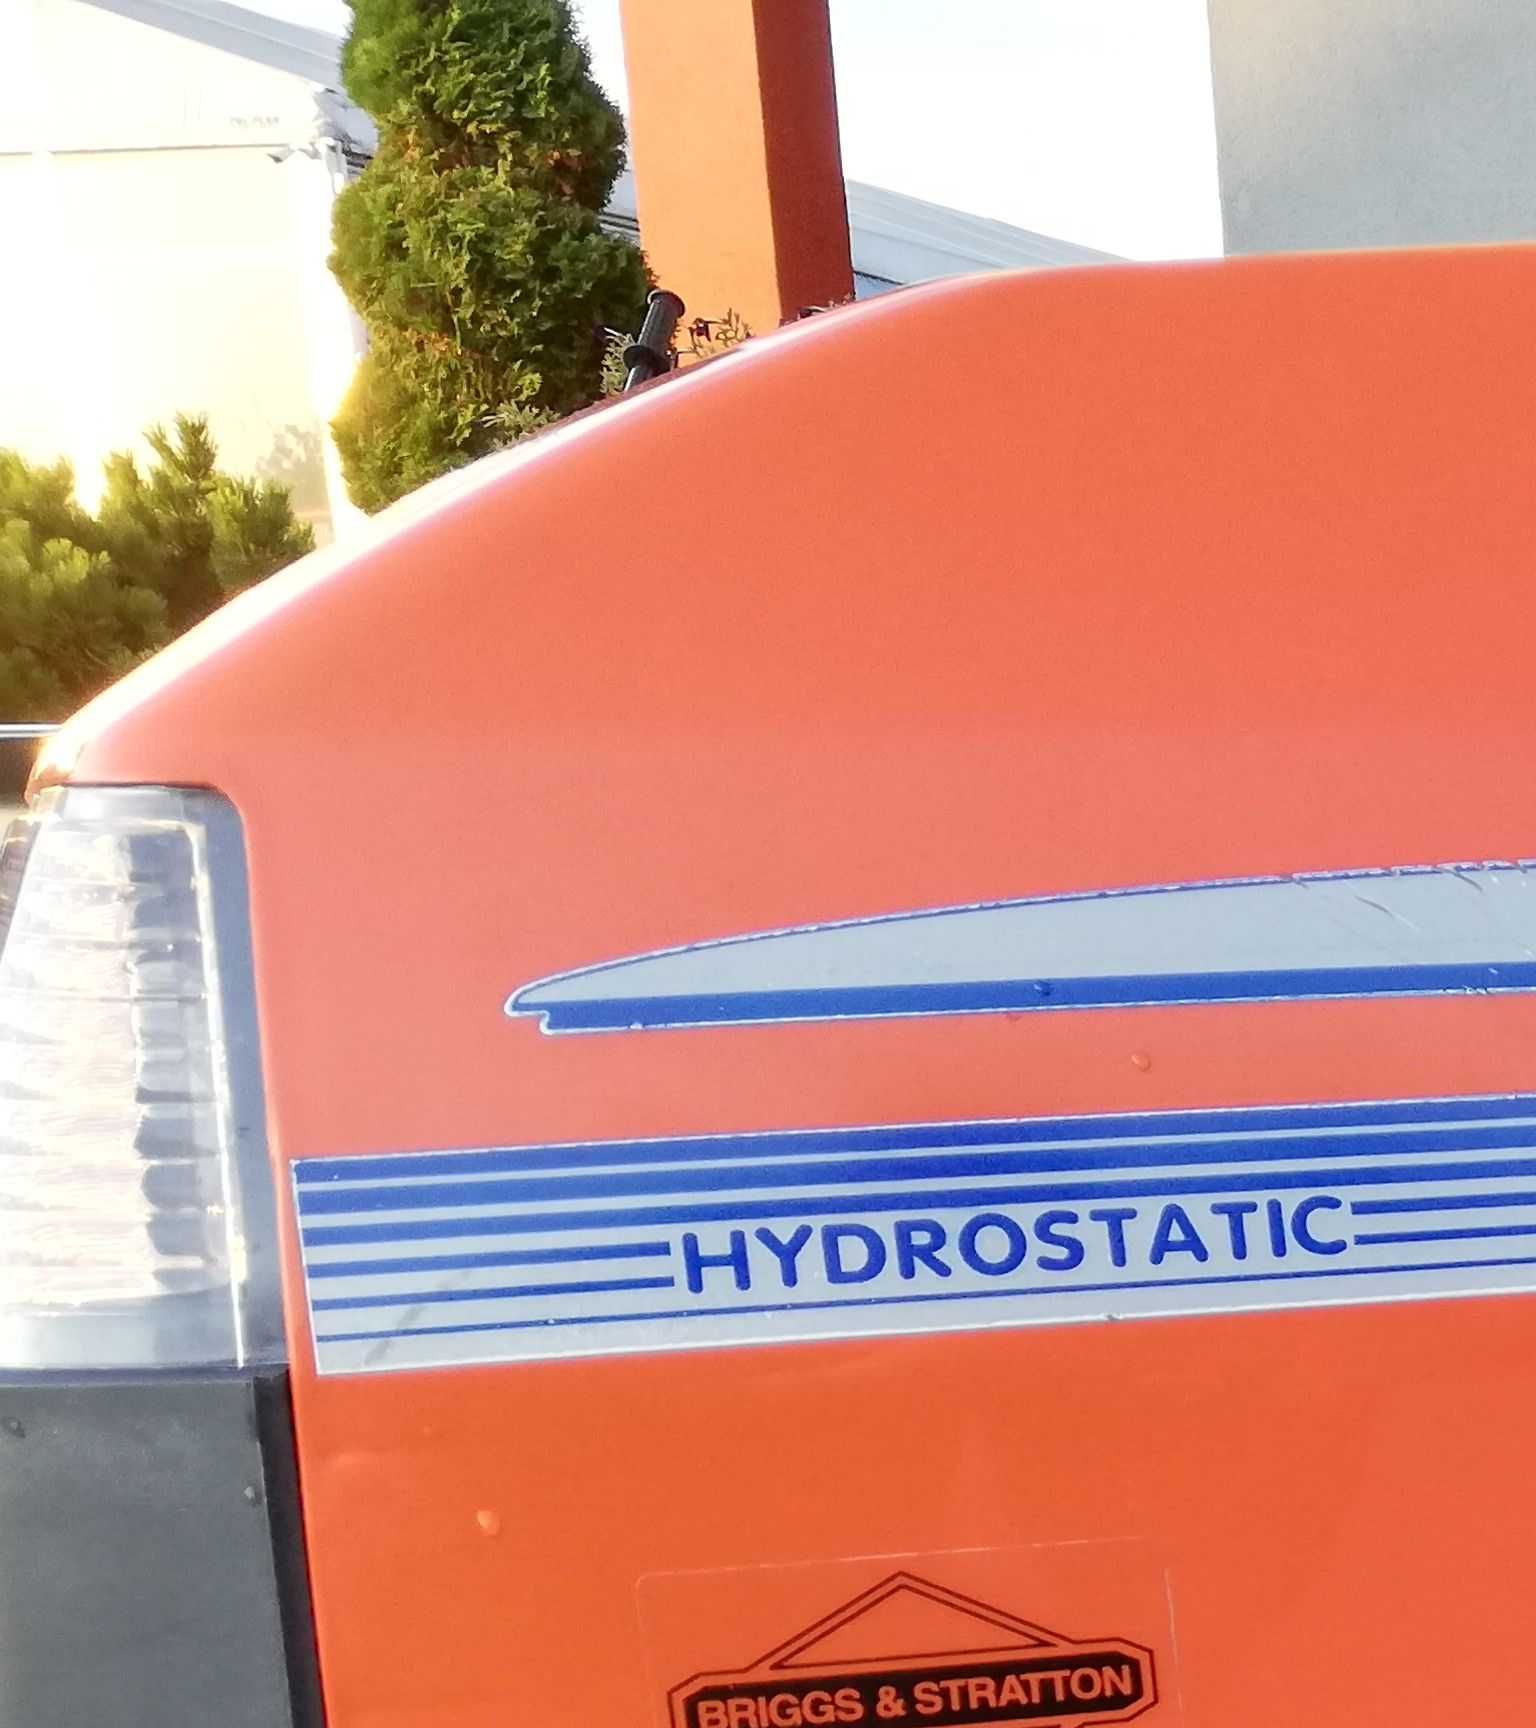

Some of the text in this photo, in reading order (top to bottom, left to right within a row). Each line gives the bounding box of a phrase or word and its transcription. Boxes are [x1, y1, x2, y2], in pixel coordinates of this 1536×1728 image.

[682, 1195, 1349, 1294] HYDROSTATIC
[875, 1685, 906, 1718] &
[914, 1664, 1133, 1716] STRATTON
